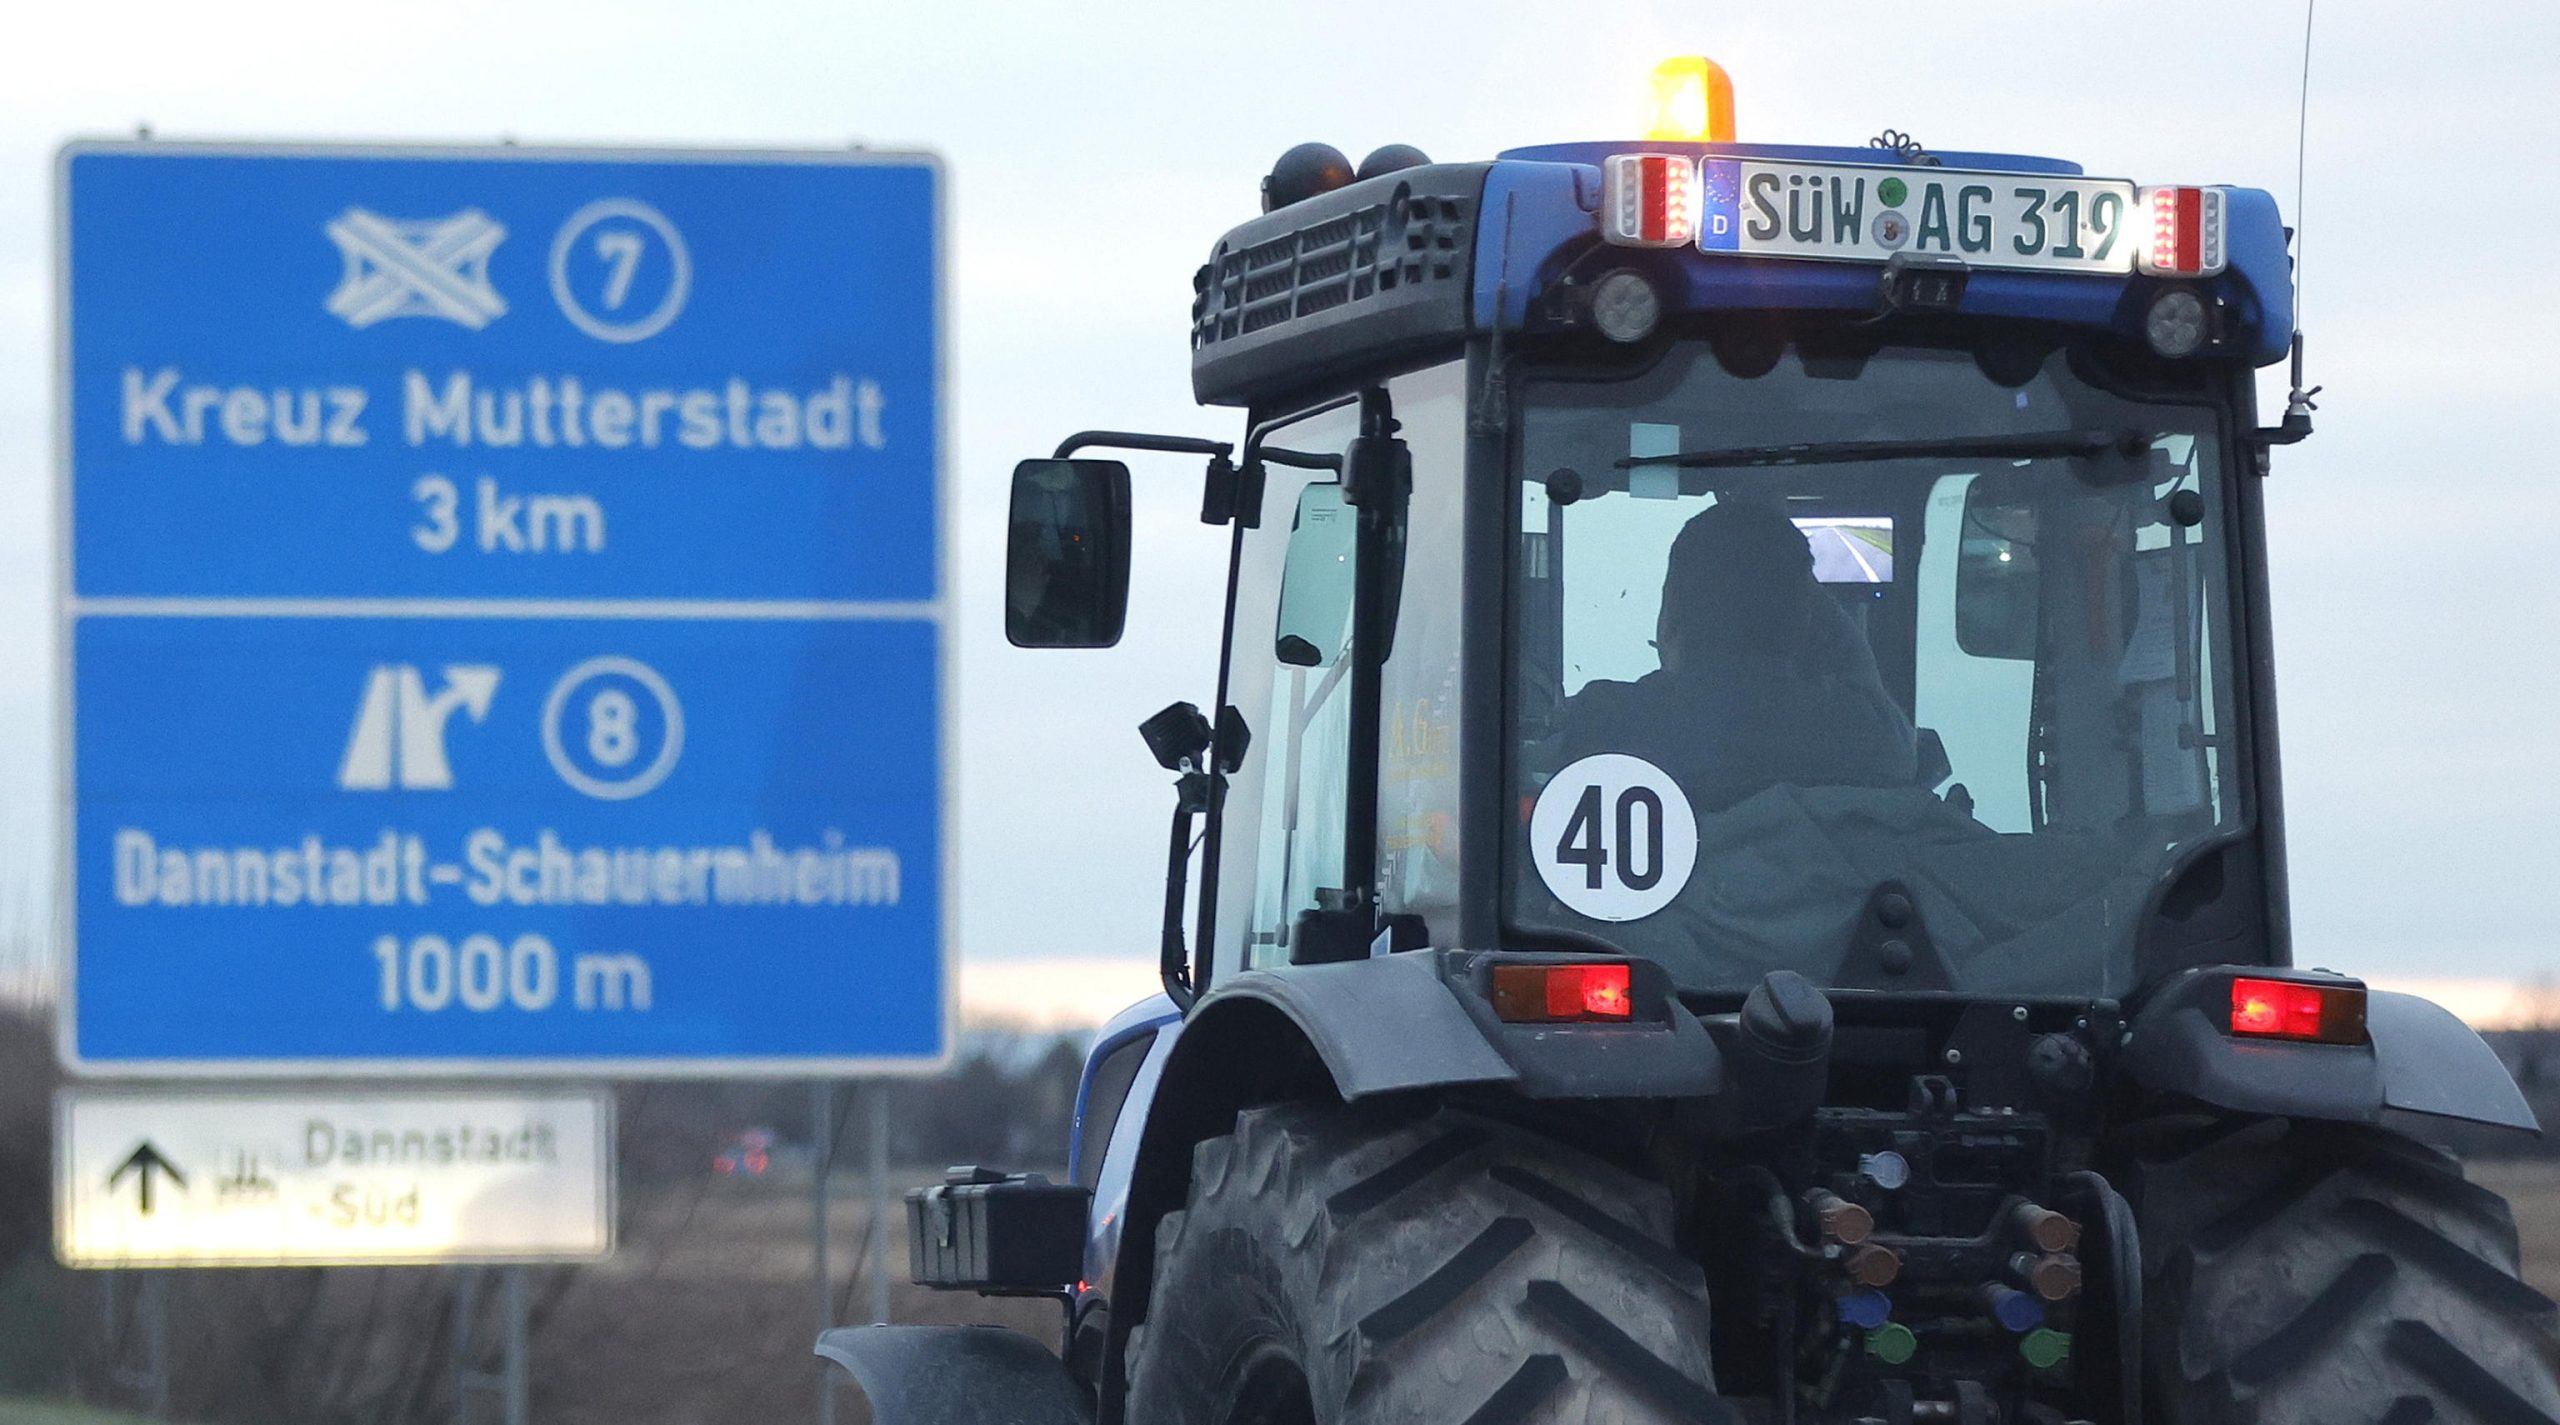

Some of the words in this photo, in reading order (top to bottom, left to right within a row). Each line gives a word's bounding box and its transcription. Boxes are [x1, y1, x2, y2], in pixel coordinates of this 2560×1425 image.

[1713, 214, 1729, 237] D
[1746, 171, 1865, 245] SÜW
[1916, 182, 1993, 254] AG
[2012, 187, 2124, 261] 319
[597, 232, 644, 311] 7
[119, 366, 370, 447] Kreuz
[403, 369, 887, 450] Mutterstadt
[412, 474, 460, 554] 3
[476, 476, 607, 554] km
[587, 689, 639, 768] 8
[113, 827, 901, 906] Dannstadt-Schauernheim
[1556, 784, 1664, 891] 40
[372, 934, 558, 1012] 1000
[573, 951, 652, 1012] m
[304, 1116, 558, 1167] Dannstadt
